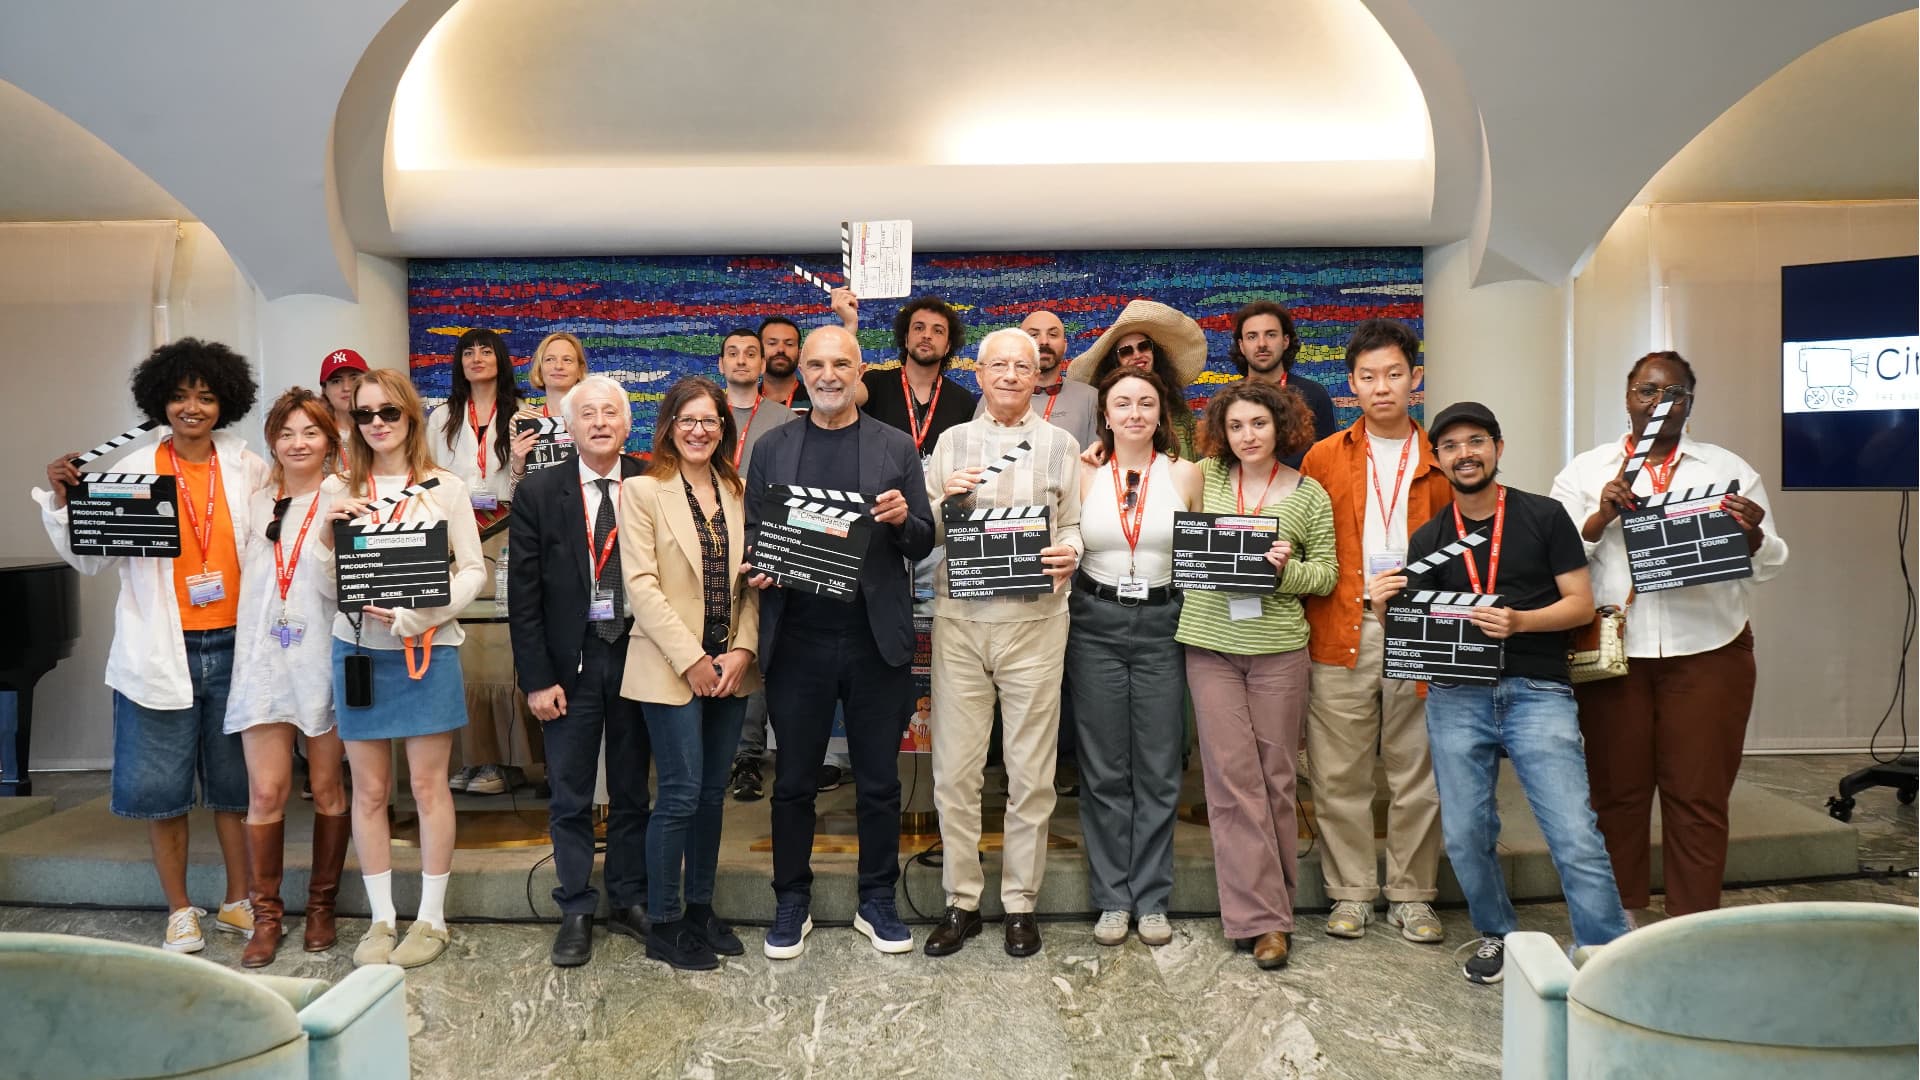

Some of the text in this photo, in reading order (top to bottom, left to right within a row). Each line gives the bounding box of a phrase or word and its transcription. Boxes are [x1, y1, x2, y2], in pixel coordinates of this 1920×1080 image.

[333, 351, 348, 364] NY
[801, 511, 850, 529] Cinemadamare
[1625, 514, 1660, 525] PROD.NO.
[1631, 523, 1656, 533] SCENE
[1672, 517, 1692, 526] TAKE
[762, 520, 802, 534] HOLLYWOOD
[368, 535, 425, 546] Cinemadamare
[760, 531, 801, 545] PRODUCTION
[1701, 538, 1728, 548] SOUND
[757, 541, 790, 553] DIRECTOR
[755, 551, 782, 562] CAMERA
[1632, 551, 1650, 559] DATE
[340, 562, 383, 570] PRODUCTION
[1633, 560, 1668, 569] PROD.CO.
[341, 572, 374, 580] DIRECTOR
[758, 562, 846, 588] DATE SCENE TAKE
[1635, 570, 1672, 581] DIRECTOR
[1174, 582, 1216, 590] CAMERAMAN
[1637, 580, 1683, 592] CAMERAMAN
[1389, 607, 1424, 615] PROD.NO.
[1388, 650, 1422, 658] PROD.CO.
[1387, 661, 1424, 669] DIRECTOR
[1387, 672, 1432, 680] CAMERAMAN
